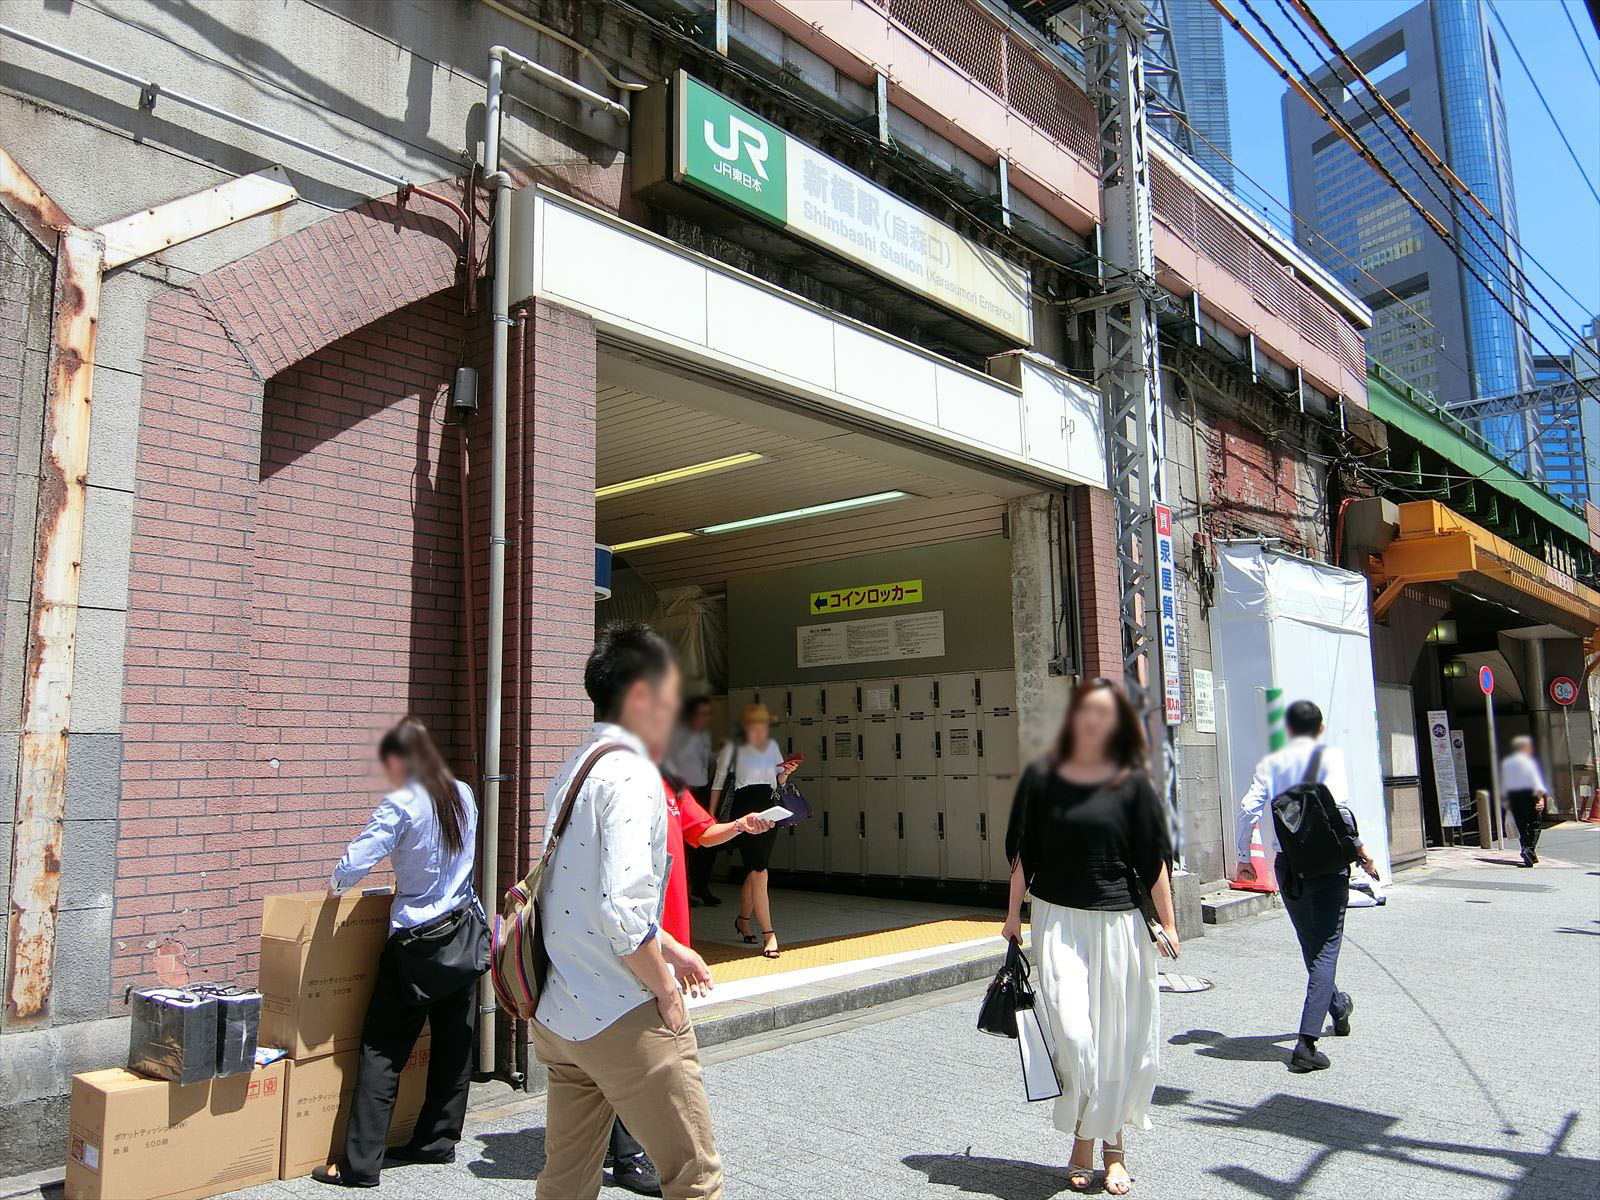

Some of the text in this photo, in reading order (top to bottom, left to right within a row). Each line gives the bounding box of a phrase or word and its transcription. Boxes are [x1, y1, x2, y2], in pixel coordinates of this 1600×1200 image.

[704, 114, 769, 181] JR
[713, 160, 763, 193] JR東日本
[803, 200, 1016, 325] Shimbashi Station (Karasumori Entrance)
[830, 584, 918, 609] コインロッカー
[1160, 539, 1175, 648] 泉屋質店
[145, 1138, 169, 1149] 500個
